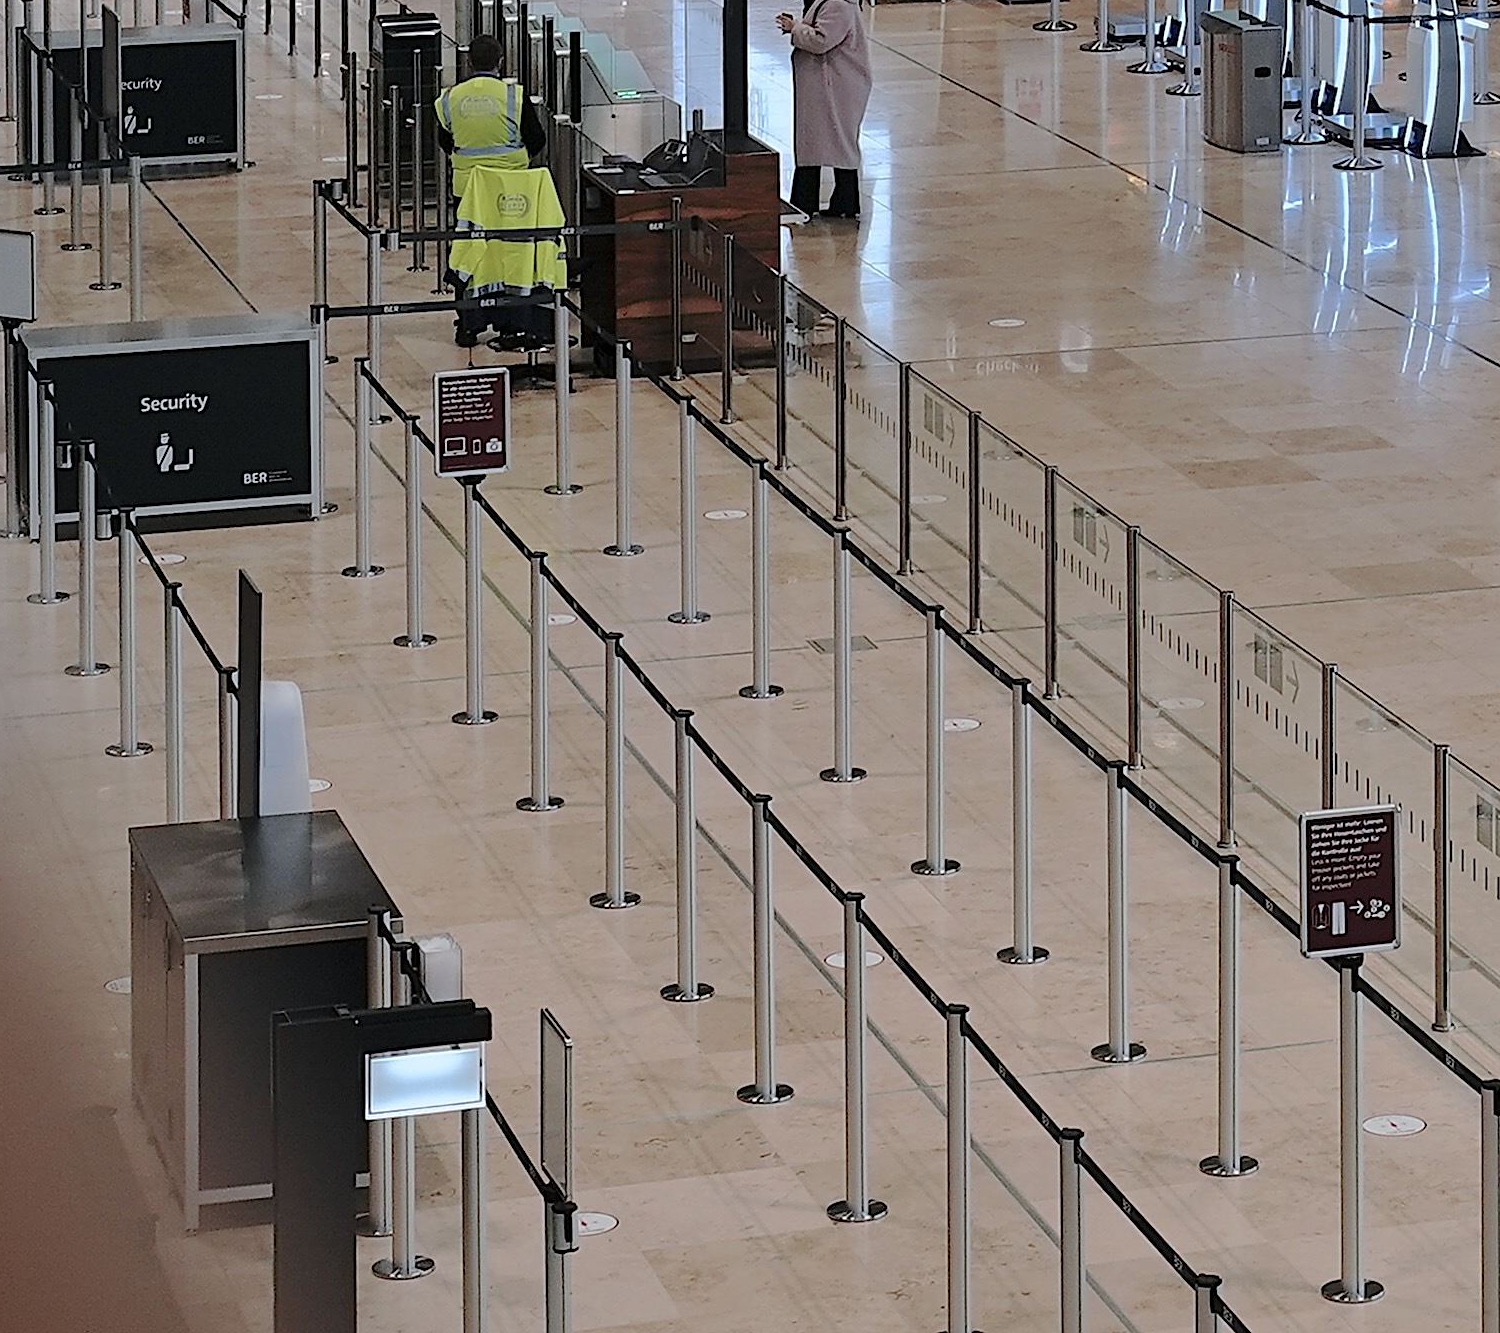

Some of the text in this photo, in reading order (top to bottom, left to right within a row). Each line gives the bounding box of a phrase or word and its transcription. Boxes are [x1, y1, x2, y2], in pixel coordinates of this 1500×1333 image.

[120, 76, 162, 92] ecurity
[187, 136, 206, 145] BER
[140, 392, 208, 413] Security
[243, 472, 268, 485] BER
